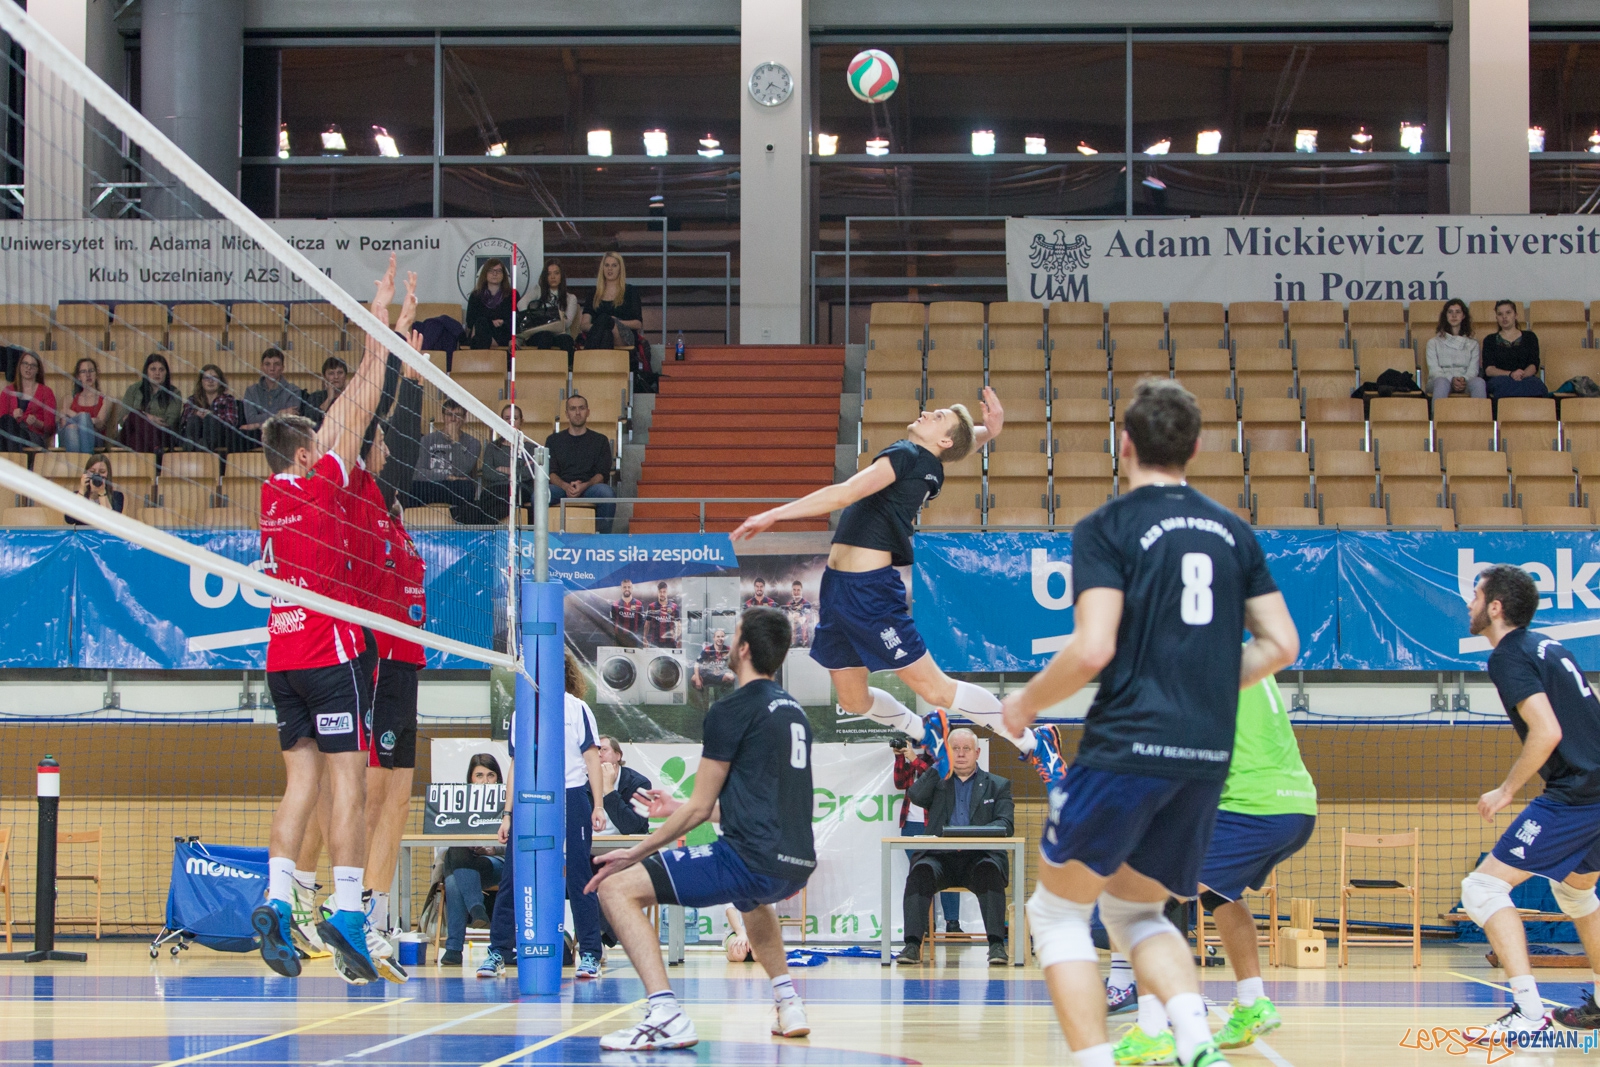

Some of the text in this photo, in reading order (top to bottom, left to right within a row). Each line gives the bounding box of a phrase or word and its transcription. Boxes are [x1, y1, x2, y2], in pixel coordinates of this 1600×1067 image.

[1, 235, 440, 254] Uniwersytet im. Adama Mickicza w Poznaniu
[1104, 229, 1212, 258] Adam
[1223, 226, 1424, 256] Mickiewicz
[460, 240, 528, 278] KLUB UCZELNANY
[89, 266, 332, 286] Klub Uczelniany AZS UM
[1030, 272, 1090, 302] UAM
[1274, 271, 1449, 301] in Poznań
[585, 549, 615, 562] nas
[619, 546, 648, 562] siła
[652, 545, 724, 565] zespołu.
[574, 571, 596, 580] Beko.
[1181, 552, 1214, 626] 8
[1560, 657, 1592, 697] 2
[789, 722, 807, 769] 6
[1132, 742, 1163, 757] PLAY
[524, 886, 533, 927] Senoh
